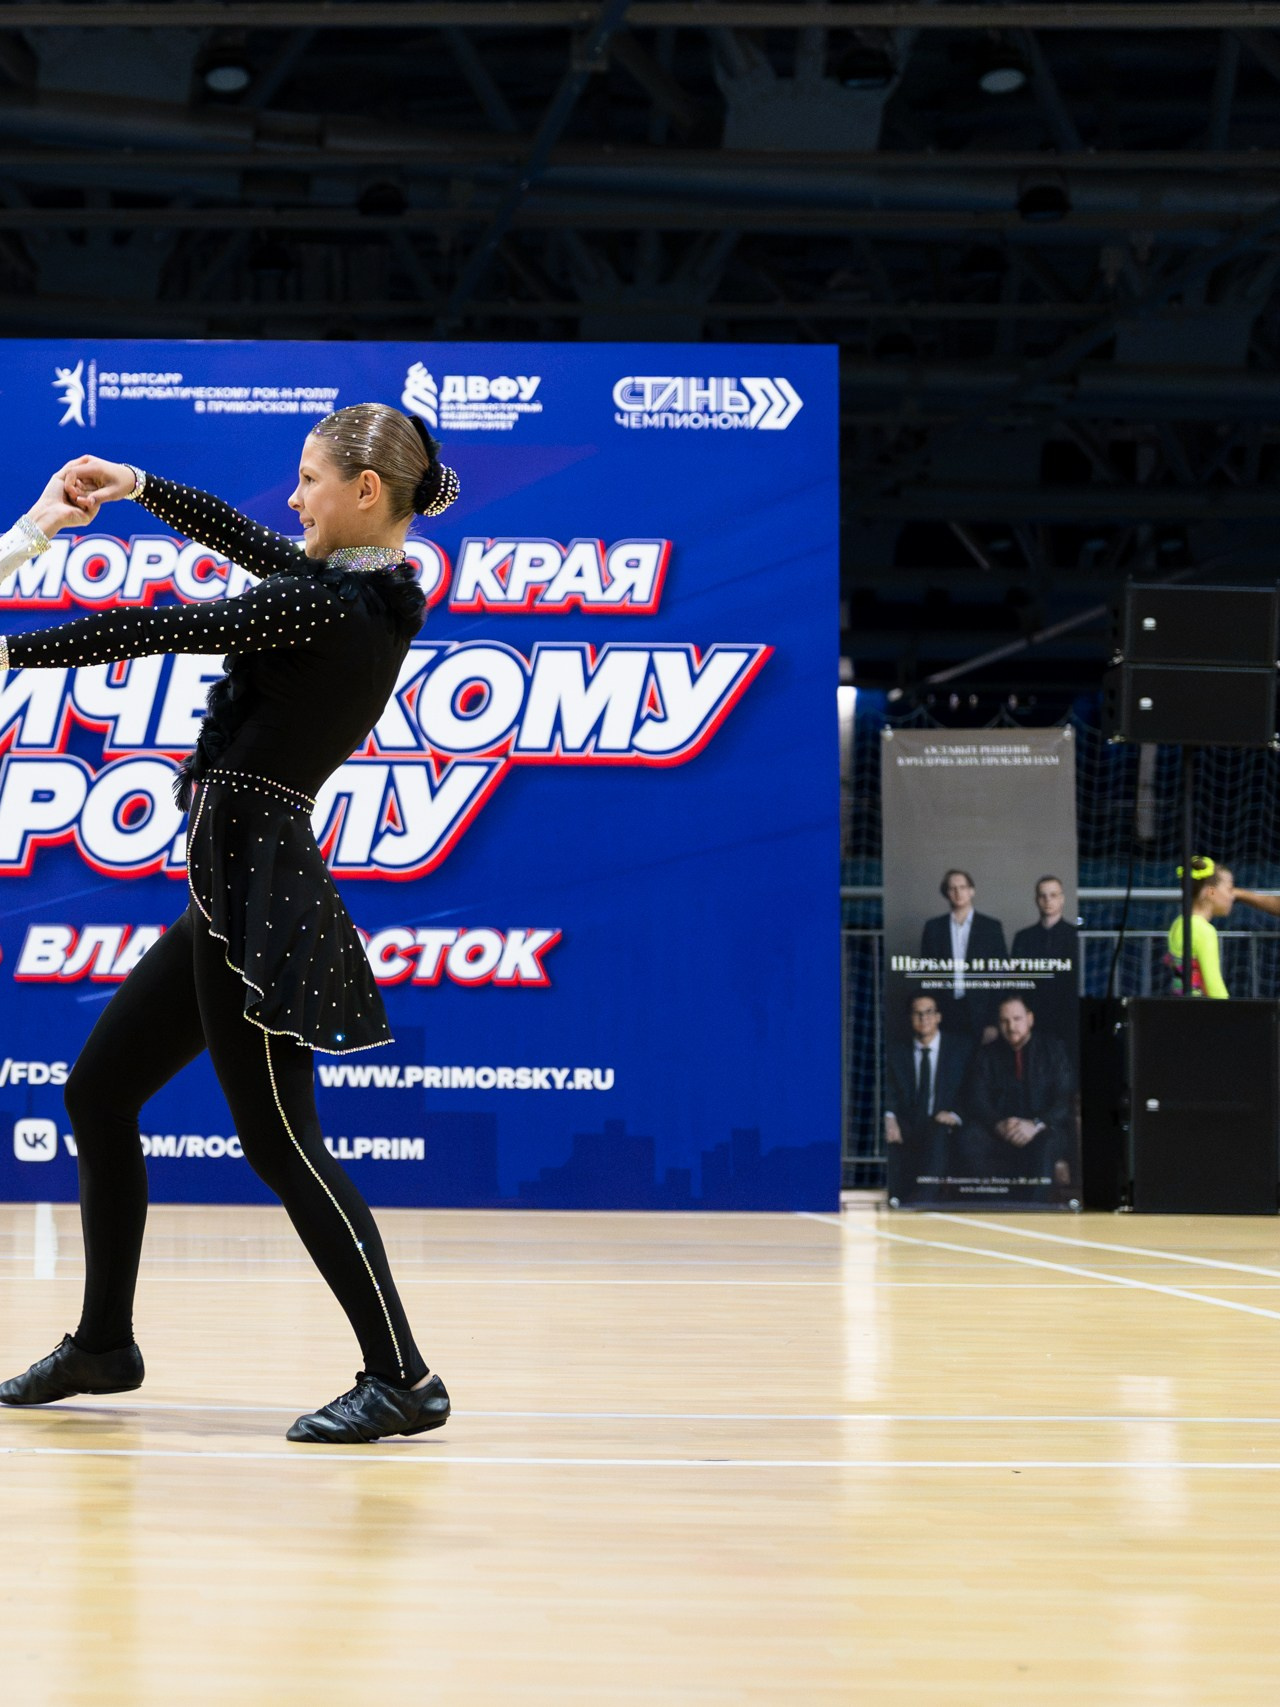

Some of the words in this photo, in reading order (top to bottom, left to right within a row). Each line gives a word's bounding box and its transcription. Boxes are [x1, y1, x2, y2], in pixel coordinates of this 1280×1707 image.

[99, 372, 119, 385] РО
[440, 375, 541, 401] ДВФУ
[99, 385, 120, 399] ПО
[121, 386, 251, 400] АКРОБАТИЧЕСКОМУ
[613, 376, 750, 412] СТАНЬ
[194, 399, 205, 413] В
[207, 401, 299, 414] ПРИМОРСКОМ
[301, 402, 334, 414] КРАЕ
[615, 412, 753, 429] ЧЕМПИОНОМ
[449, 537, 672, 613] КРАЯ
[318, 1065, 615, 1091] WWW.PRIMORSKY.RU
